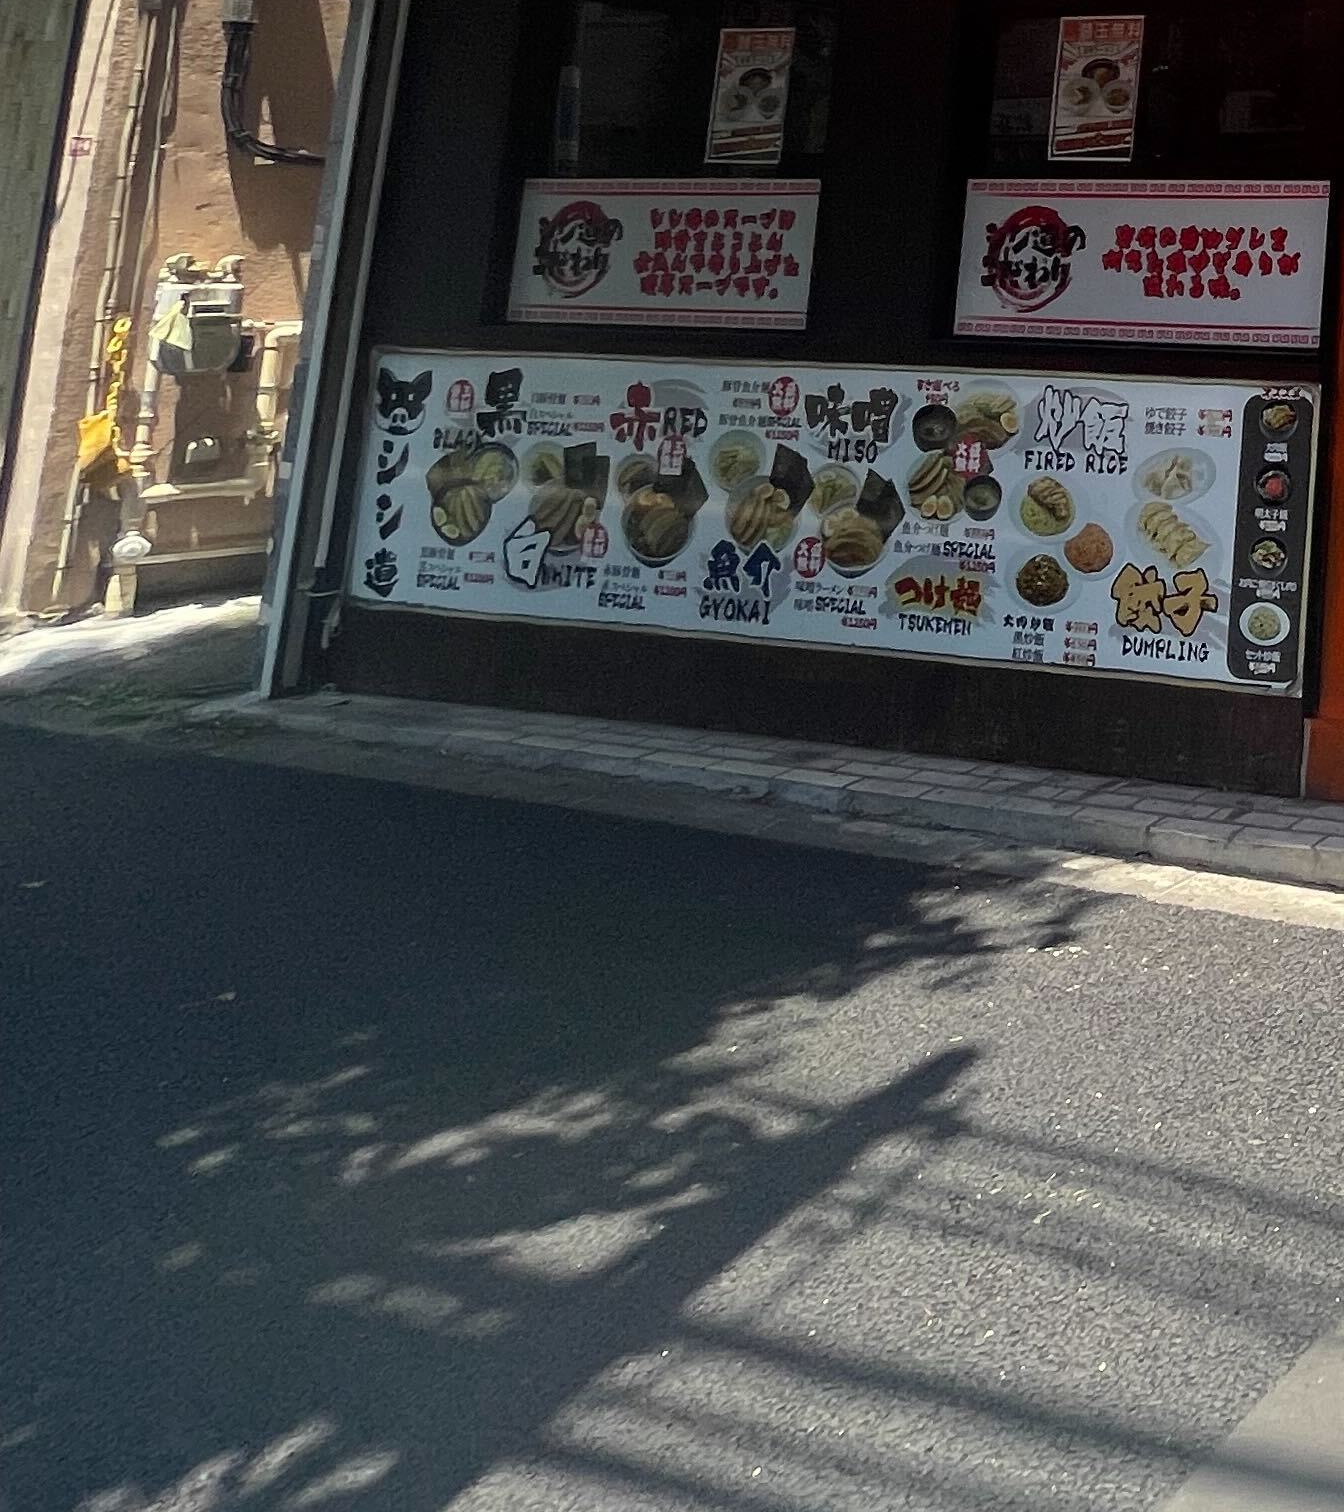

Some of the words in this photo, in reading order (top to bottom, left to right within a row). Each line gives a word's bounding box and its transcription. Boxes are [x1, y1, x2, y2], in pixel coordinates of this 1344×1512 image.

[476, 367, 527, 438] 黒
[610, 381, 661, 452] 赤
[663, 406, 709, 438] RED
[804, 382, 899, 444] 味噌
[1035, 384, 1132, 460] 炒飯
[827, 439, 879, 464] MISO
[1023, 448, 1077, 473] FIRED
[1085, 452, 1129, 476] RICE
[504, 514, 552, 589] 白
[704, 539, 782, 598] 魚介
[699, 595, 771, 626] GYOKAI
[894, 573, 983, 616] つけ麺
[1111, 562, 1219, 638] 餃子
[898, 612, 972, 637] TSUKEMEN
[1121, 634, 1211, 664] DUMPLING
